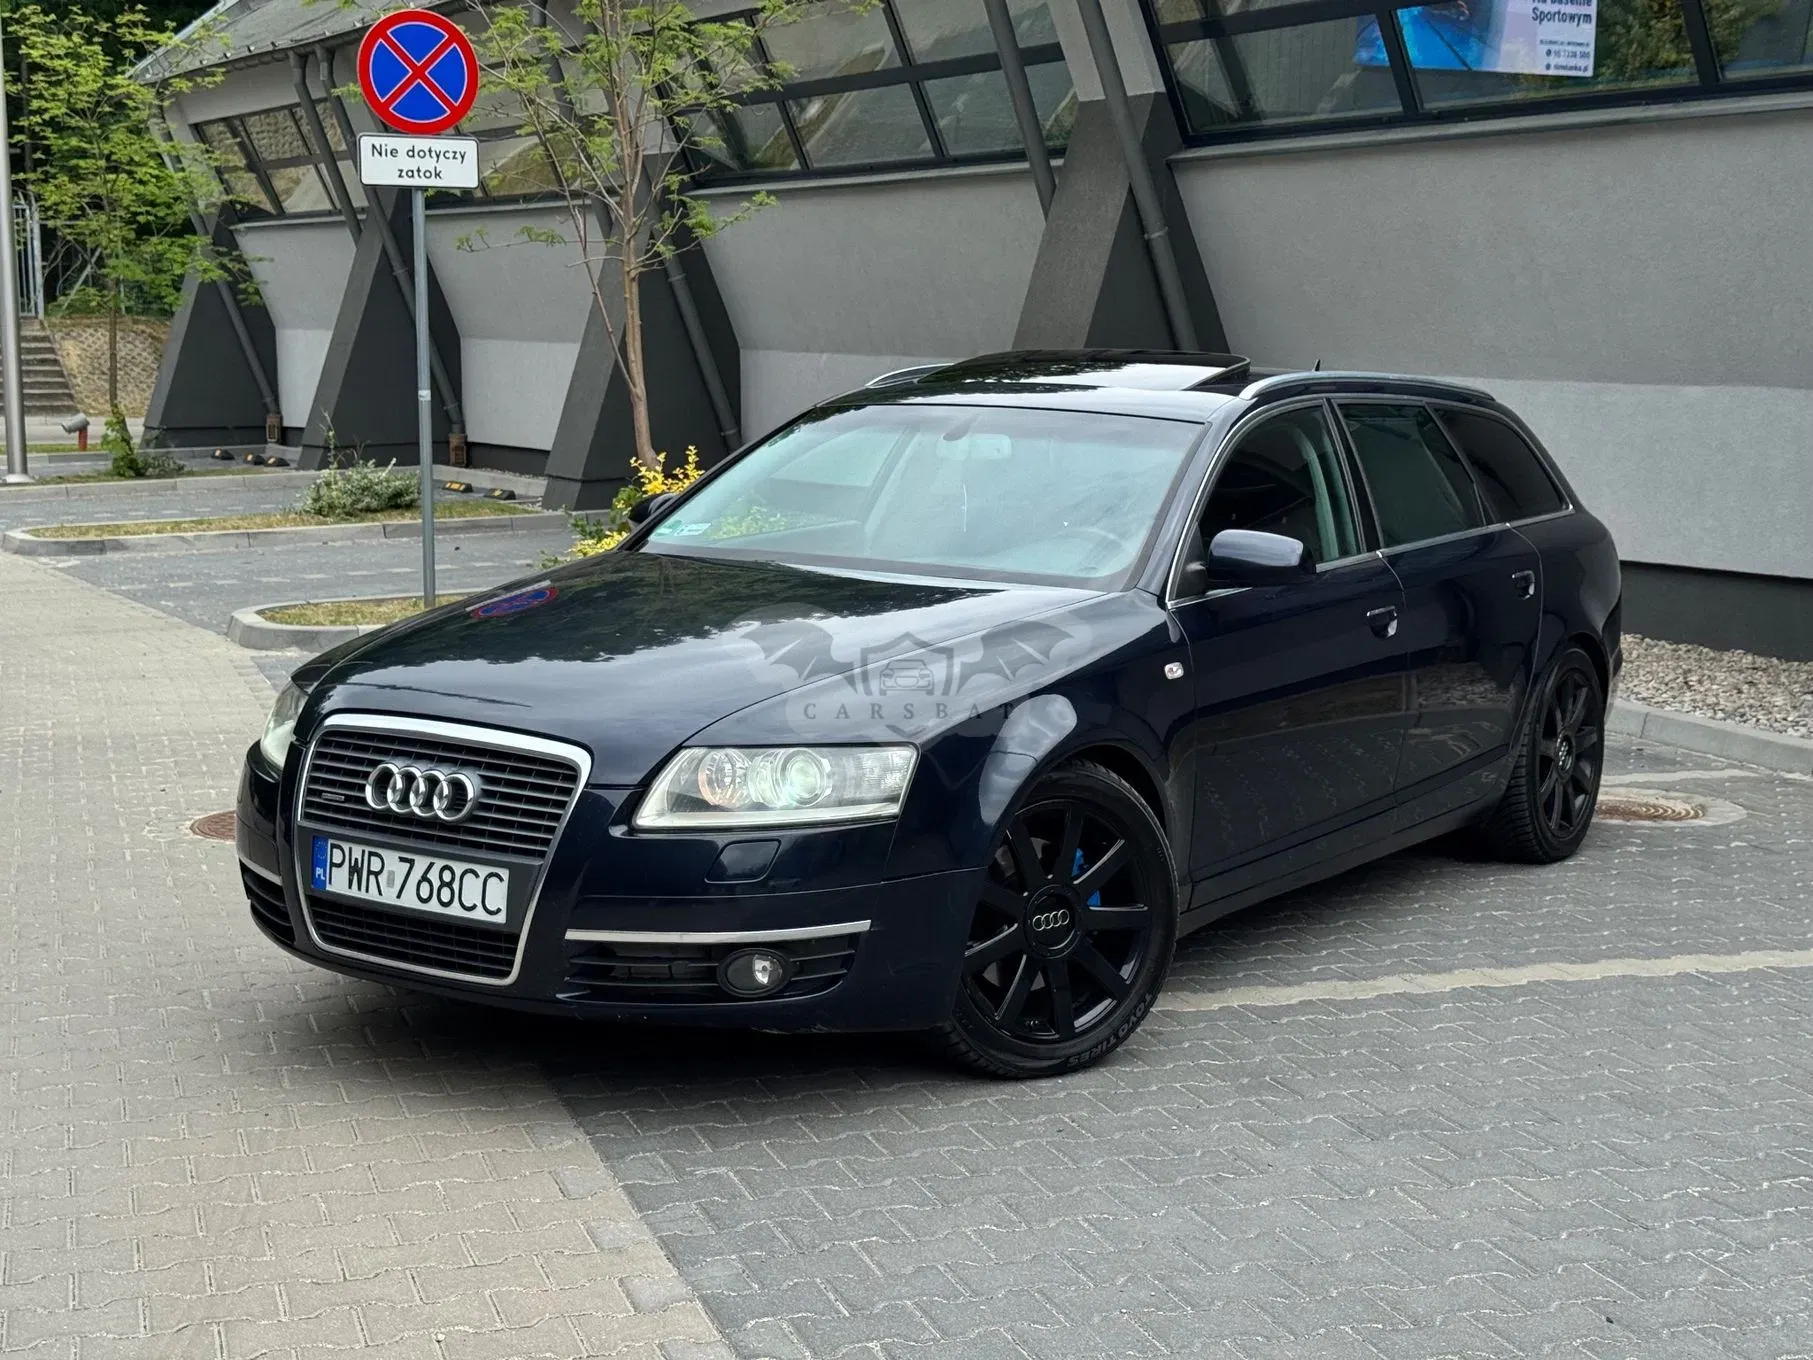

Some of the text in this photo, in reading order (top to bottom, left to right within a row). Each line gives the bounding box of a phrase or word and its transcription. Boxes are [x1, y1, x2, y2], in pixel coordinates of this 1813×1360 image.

[1531, 6, 1592, 28] Sportowym
[371, 143, 467, 165] Nie dotyczy
[397, 166, 443, 180] zatok
[315, 867, 325, 880] PL
[329, 842, 505, 917] PWR 768CC
[1118, 992, 1154, 1038] TOYO
